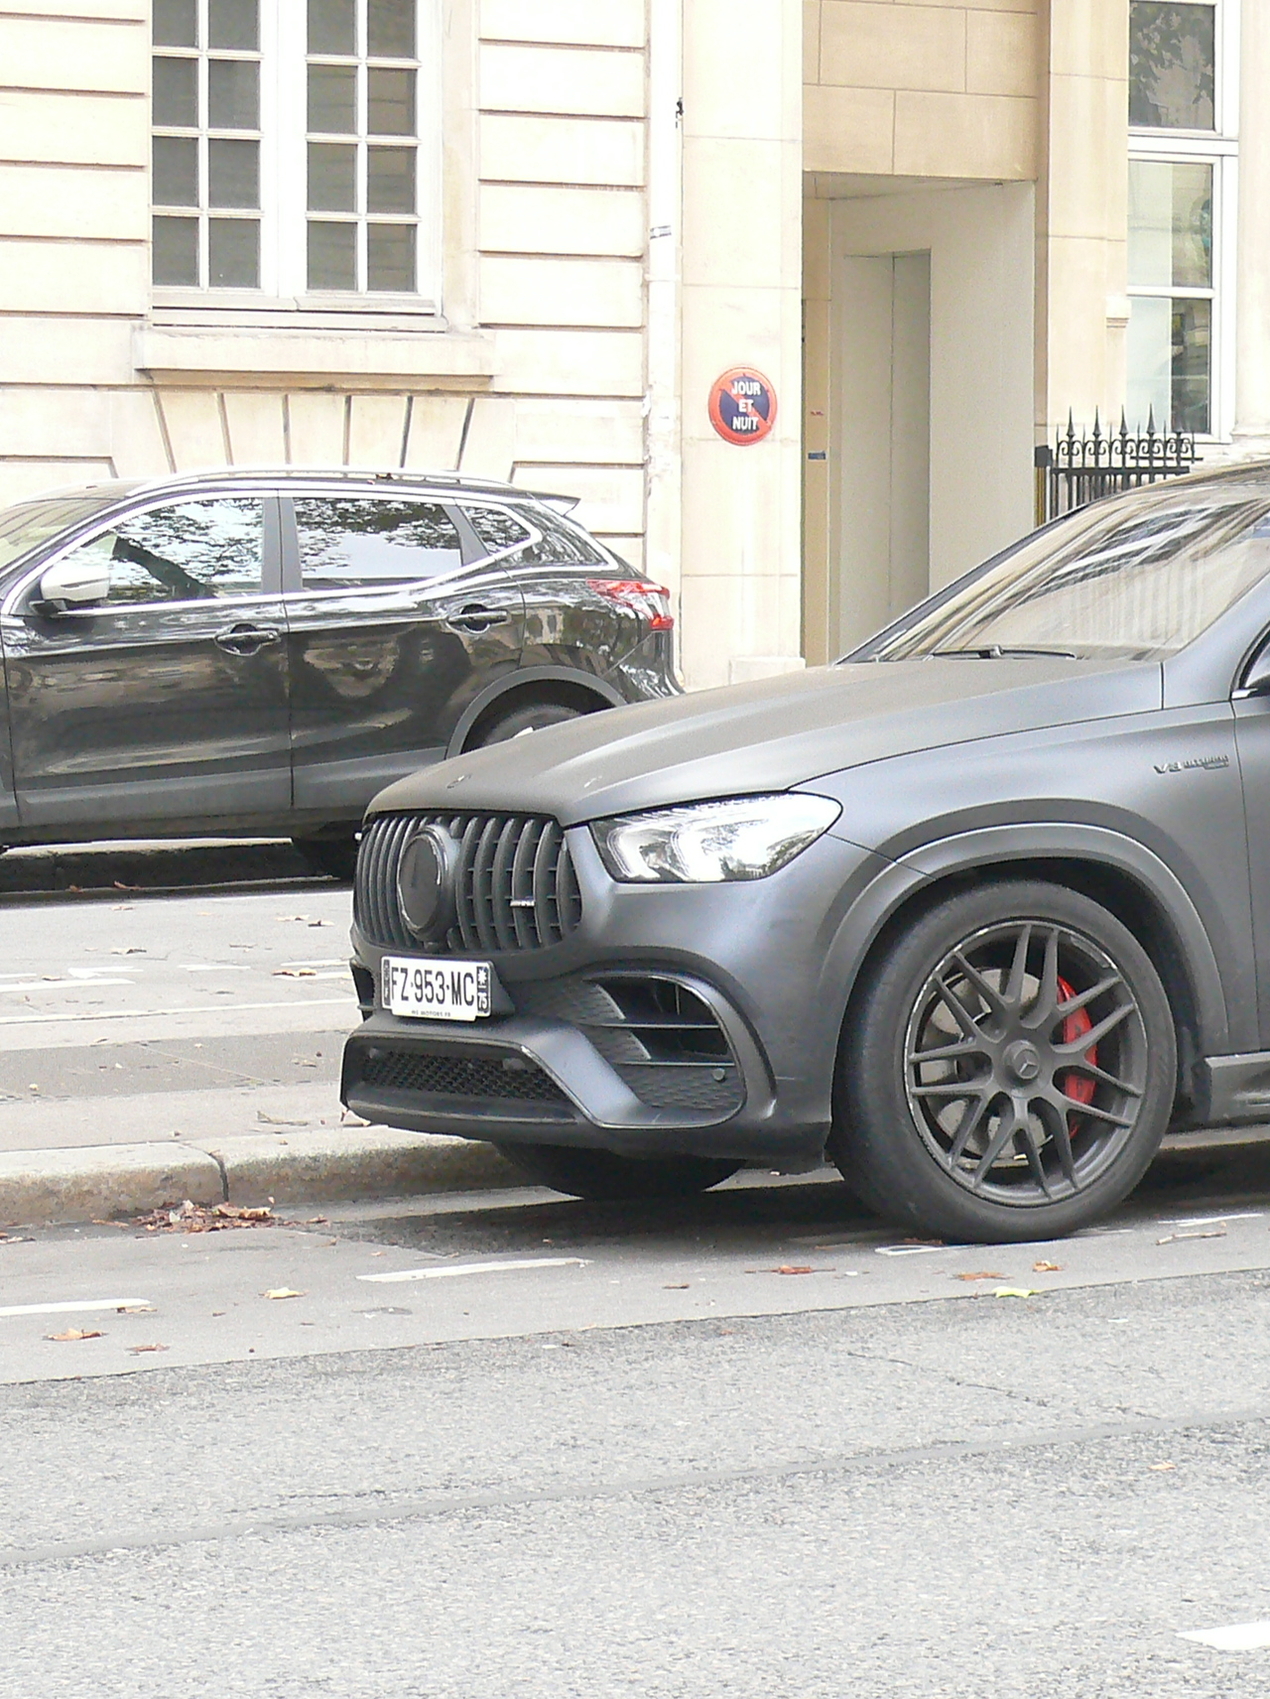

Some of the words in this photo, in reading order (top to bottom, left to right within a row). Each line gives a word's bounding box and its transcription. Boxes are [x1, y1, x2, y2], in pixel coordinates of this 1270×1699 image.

[731, 381, 761, 396] JOUR
[738, 399, 754, 413] ET
[732, 416, 759, 430] NUIT
[391, 966, 475, 1006] FZ-953-MC
